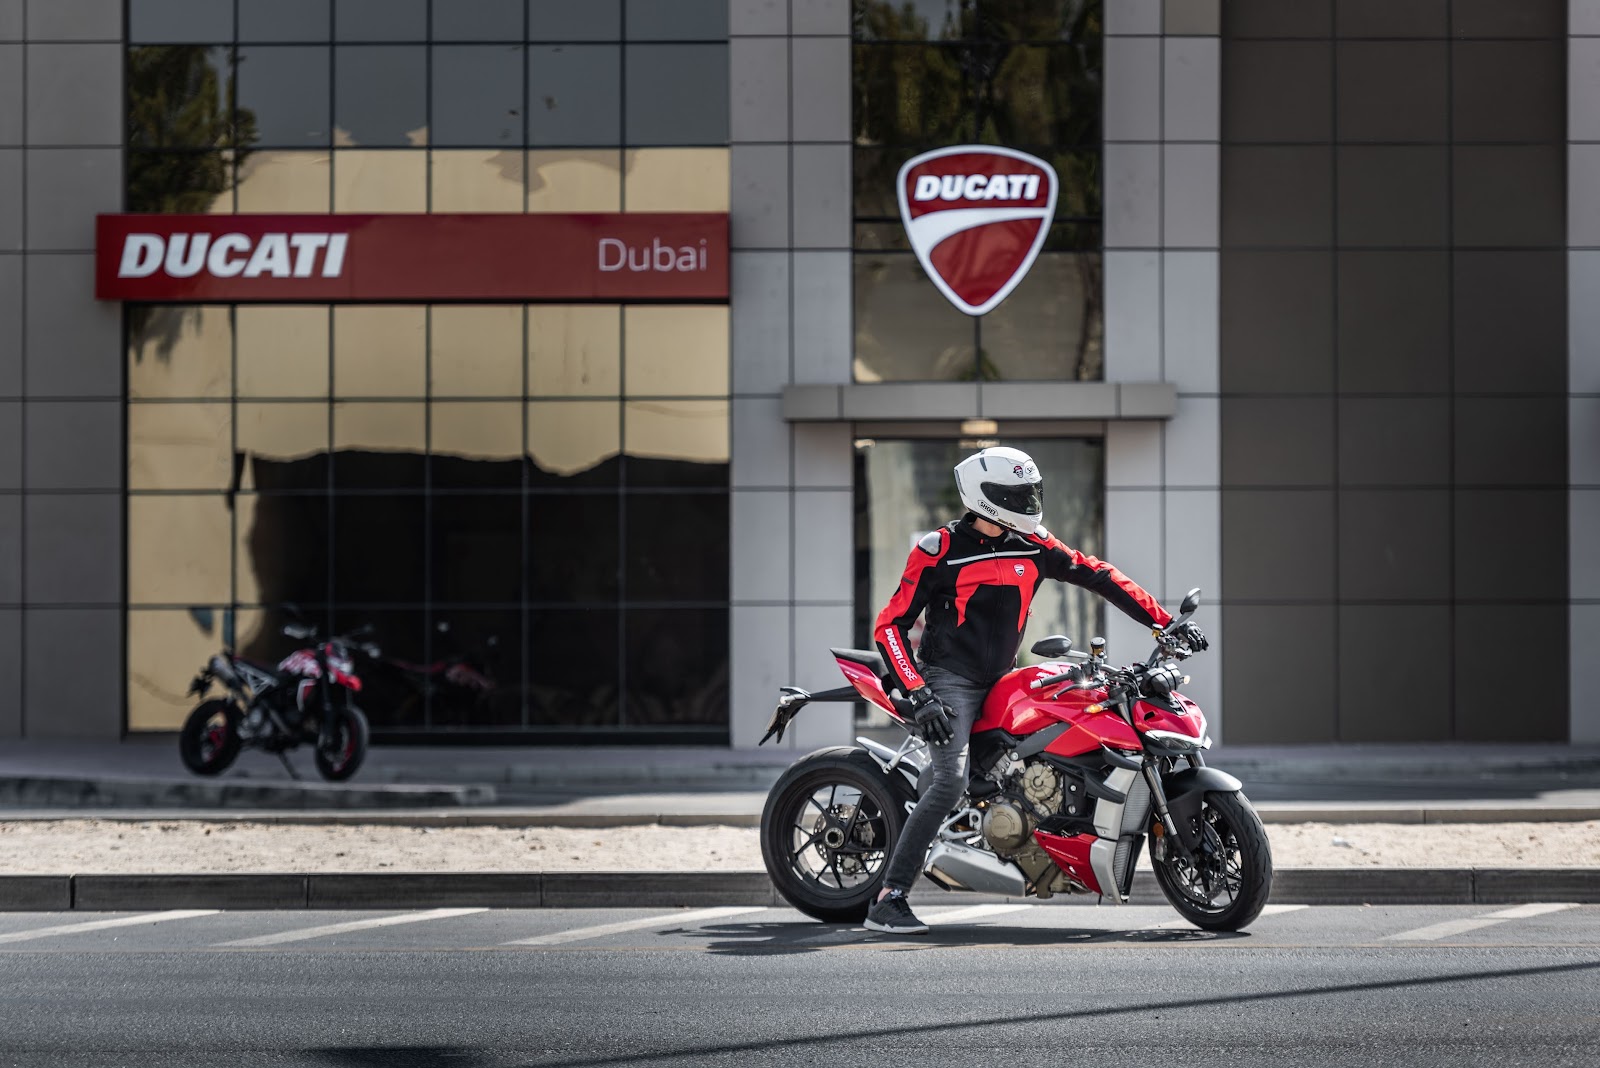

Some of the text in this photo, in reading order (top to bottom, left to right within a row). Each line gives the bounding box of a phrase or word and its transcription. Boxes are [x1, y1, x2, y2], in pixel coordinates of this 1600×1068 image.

[914, 174, 1041, 201] DUCATI
[118, 233, 707, 278] DUCATI Dubai
[980, 501, 997, 516] SHOEI
[885, 628, 918, 682] DUCATI CORSE
